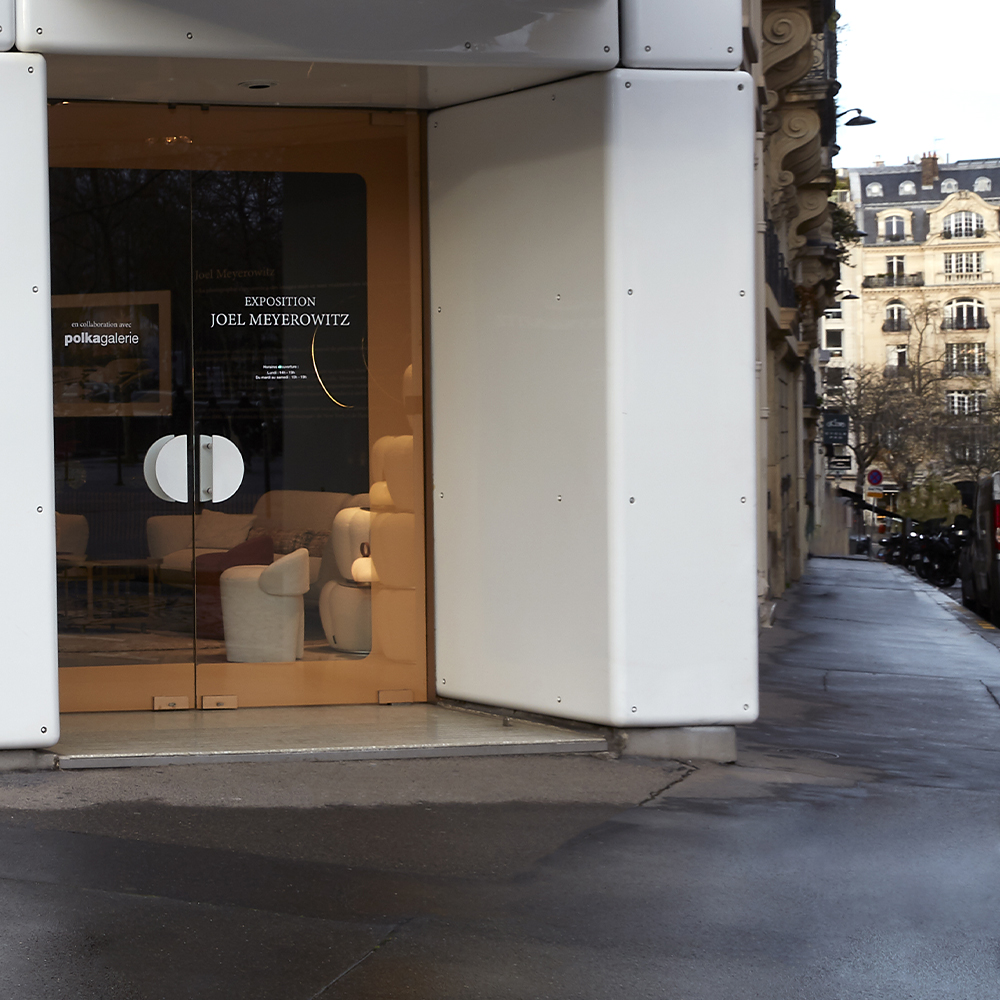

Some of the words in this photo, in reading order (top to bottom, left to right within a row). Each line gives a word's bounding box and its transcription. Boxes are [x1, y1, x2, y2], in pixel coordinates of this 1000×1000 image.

[245, 296, 317, 307] EXPOSITION
[80, 320, 118, 328] collaboration
[210, 313, 246, 328] JOEL
[249, 313, 351, 327] MEYEROWITZ
[64, 331, 139, 347] polkagalerie
